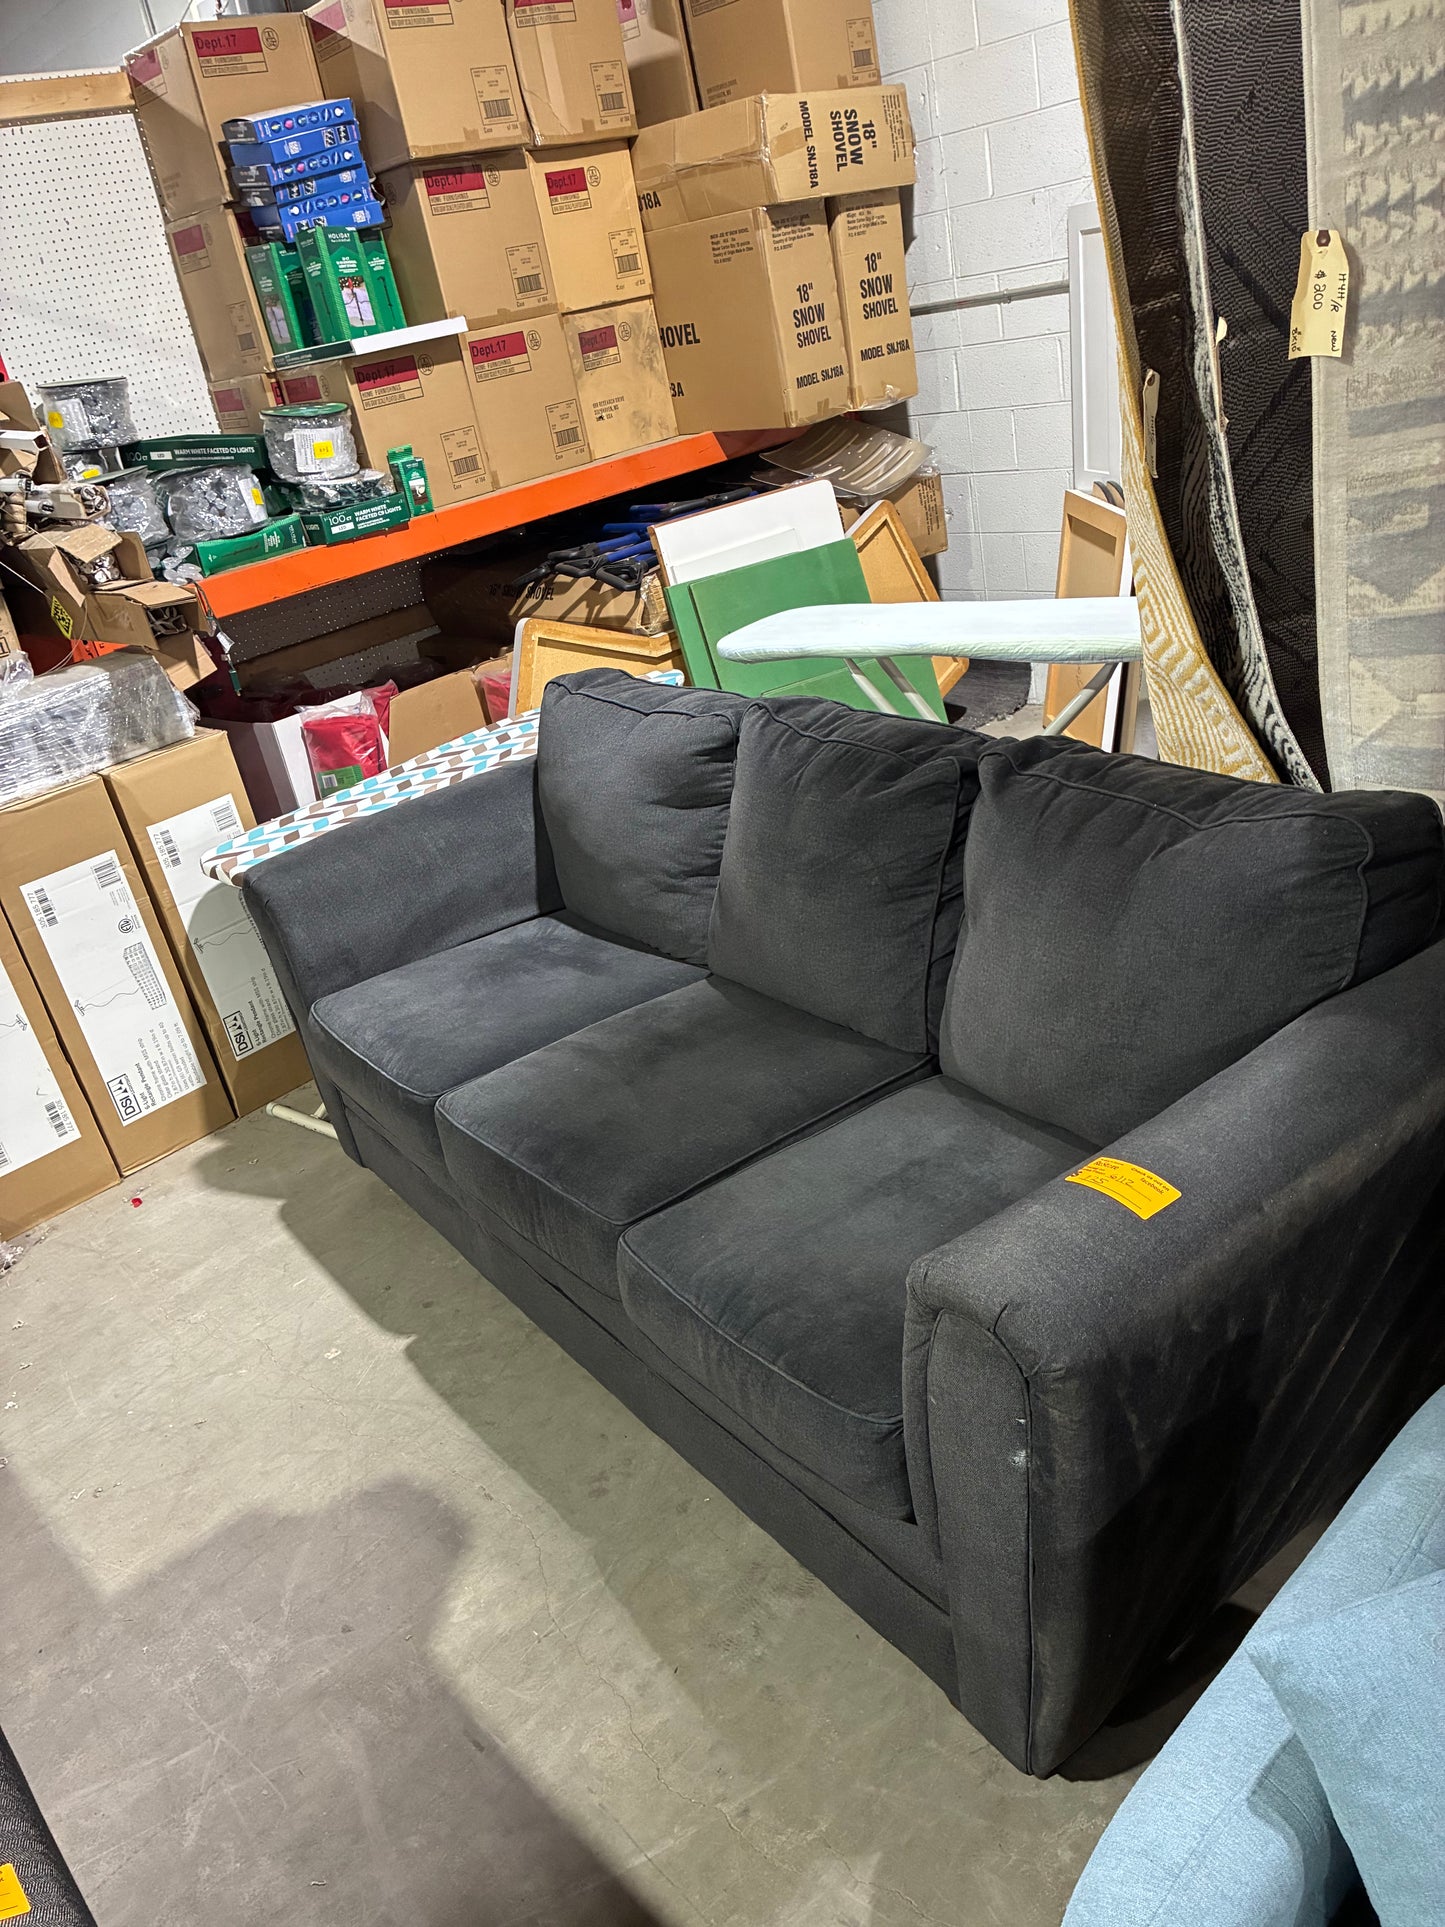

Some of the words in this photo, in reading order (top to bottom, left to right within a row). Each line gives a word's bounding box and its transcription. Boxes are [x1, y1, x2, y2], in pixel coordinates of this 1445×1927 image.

[195, 34, 236, 51] Dept.17
[799, 101, 814, 141] MODEL
[830, 110, 848, 172] SHOVEL
[844, 109, 863, 165] SNOW
[862, 120, 877, 148] 18"
[806, 145, 819, 188] SNJ18A
[426, 172, 463, 189] Dept.17
[865, 252, 882, 273] 18"
[796, 282, 813, 303] 18"
[860, 274, 893, 299] SNOW
[793, 303, 825, 328] SNOW
[863, 297, 898, 320] SHOVEL
[797, 325, 831, 349] SHOVEL
[471, 340, 506, 357] Dept.17
[861, 344, 885, 361] MODEL
[887, 339, 910, 356] SNJ18A
[357, 365, 395, 384] Dept.17
[797, 372, 820, 388] MODEL
[821, 364, 844, 382] SNJ18A
[329, 515, 346, 525] 100
[354, 508, 371, 517] WARM
[371, 504, 387, 512] WHITE
[356, 512, 378, 522] FACETED
[385, 506, 402, 515] LIGHTS
[525, 583, 554, 600] SHOVEL
[153, 834, 161, 845] 777
[158, 845, 167, 857] 185
[163, 858, 172, 869] 305
[27, 892, 35, 904] 777
[32, 905, 41, 916] 185
[38, 918, 48, 929] 305
[247, 1000, 258, 1020] Pendant
[233, 1031, 248, 1051] DSI
[134, 1062, 147, 1083] Pendant
[142, 1082, 157, 1106] Rectangle
[118, 1094, 136, 1116] DSI
[55, 1099, 65, 1111] 305
[60, 1111, 69, 1122] 185
[65, 1122, 75, 1132] 777
[1140, 1177, 1164, 1195] facebook
